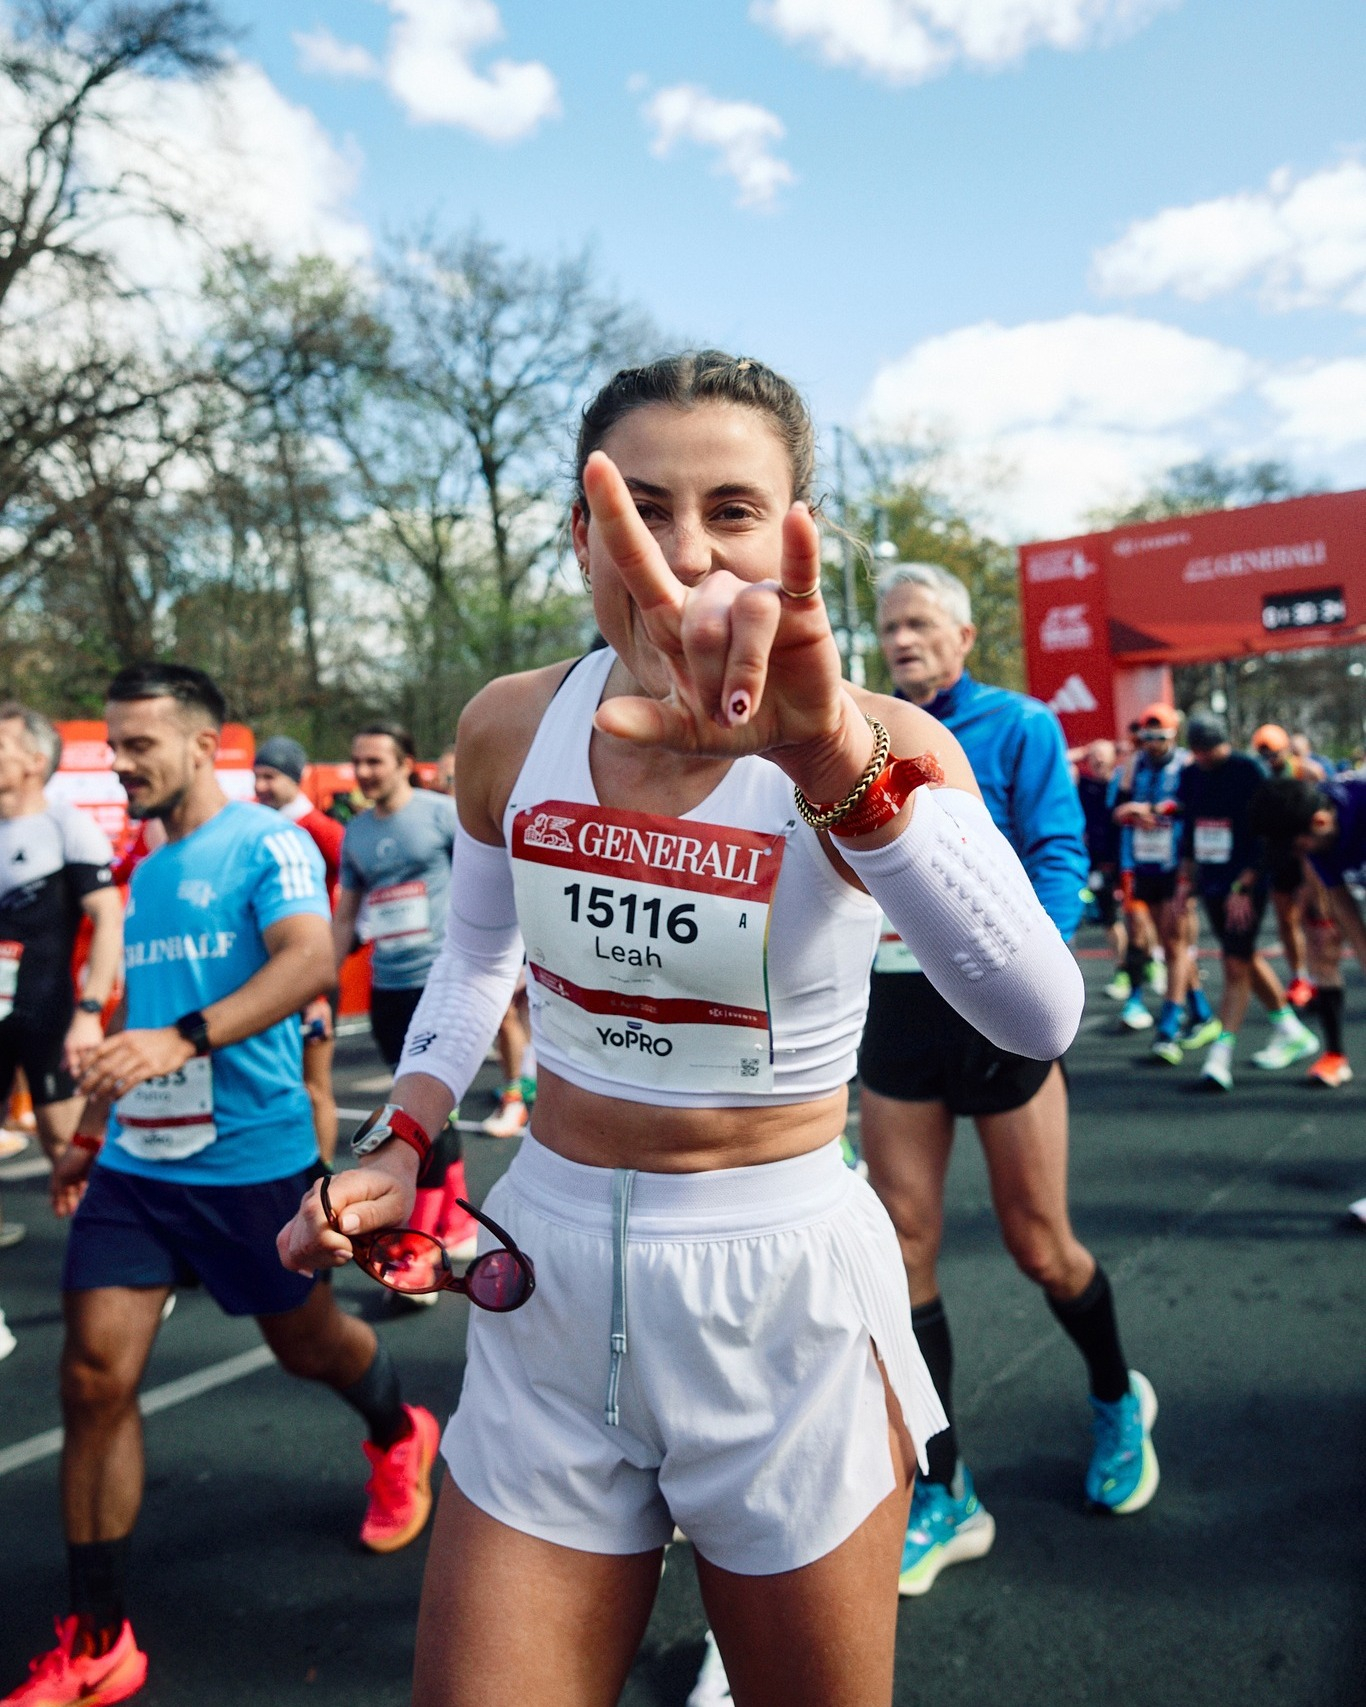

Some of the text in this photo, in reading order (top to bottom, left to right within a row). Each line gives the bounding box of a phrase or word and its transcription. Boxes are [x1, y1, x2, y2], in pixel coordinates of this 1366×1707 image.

[578, 821, 765, 885] GENERALI
[563, 883, 698, 944] 15116
[738, 913, 747, 929] A
[595, 936, 662, 968] Leah
[595, 1027, 673, 1057] YoPRO
